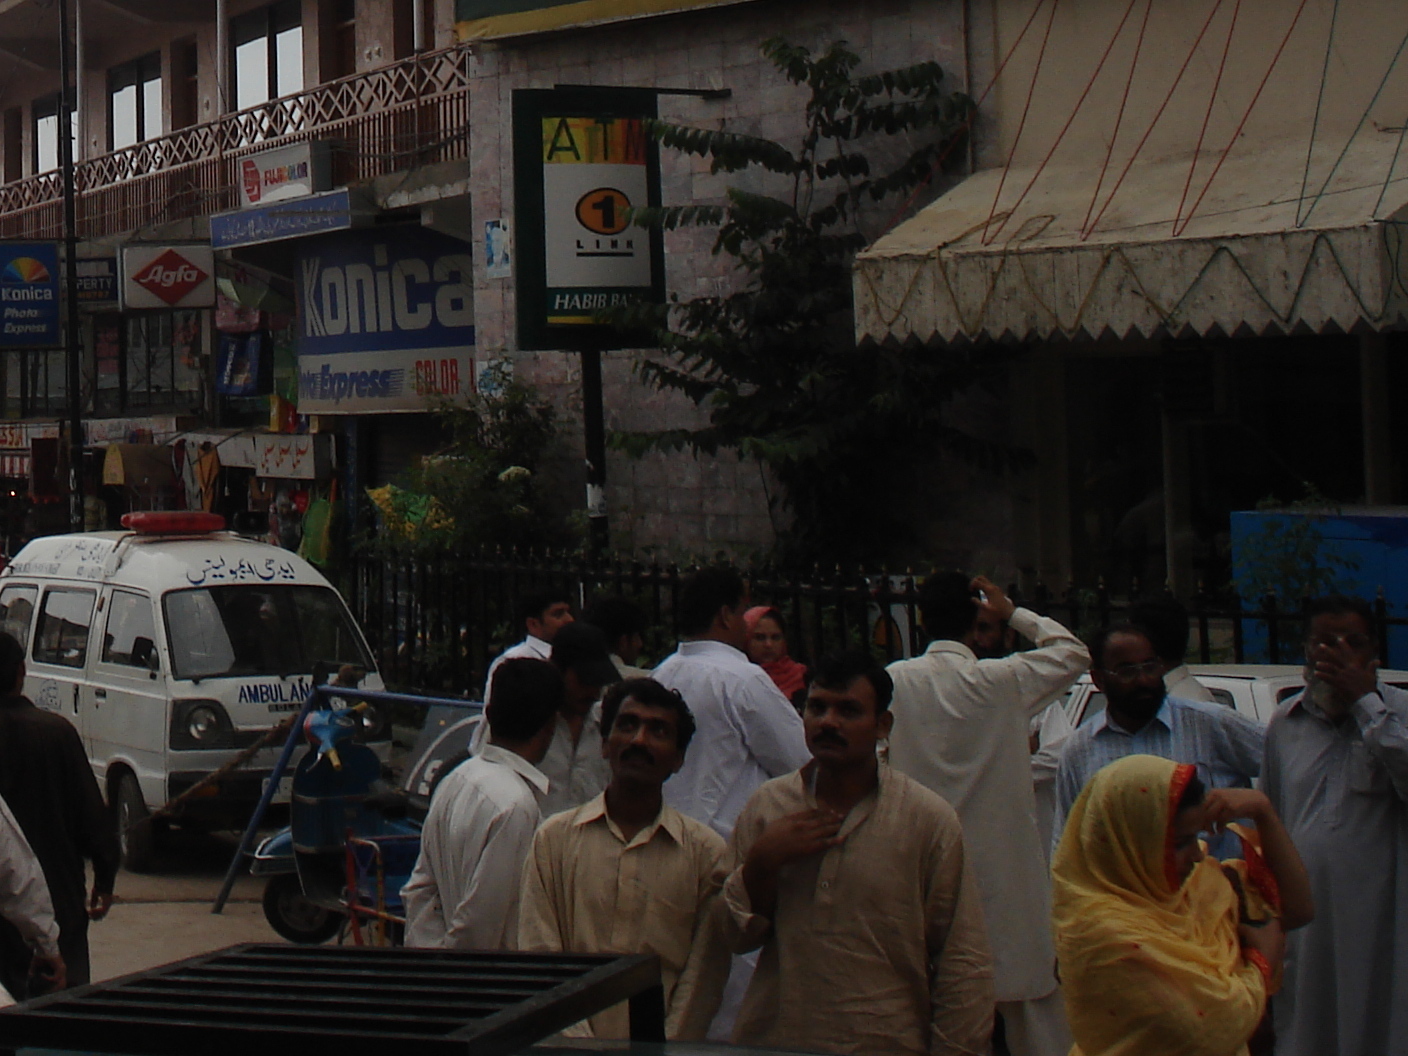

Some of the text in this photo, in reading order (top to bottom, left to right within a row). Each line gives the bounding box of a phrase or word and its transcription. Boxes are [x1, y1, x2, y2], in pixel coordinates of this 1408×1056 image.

[592, 195, 615, 229] 1
[576, 239, 634, 250] LINK
[139, 264, 199, 288] Agfa
[1, 286, 53, 302] Konica
[301, 244, 476, 338] Konica
[554, 292, 608, 311] HABIB
[3, 307, 38, 319] Photo
[3, 323, 48, 335] Express
[415, 357, 459, 397] COLOR
[238, 681, 314, 705] AMBULAN
